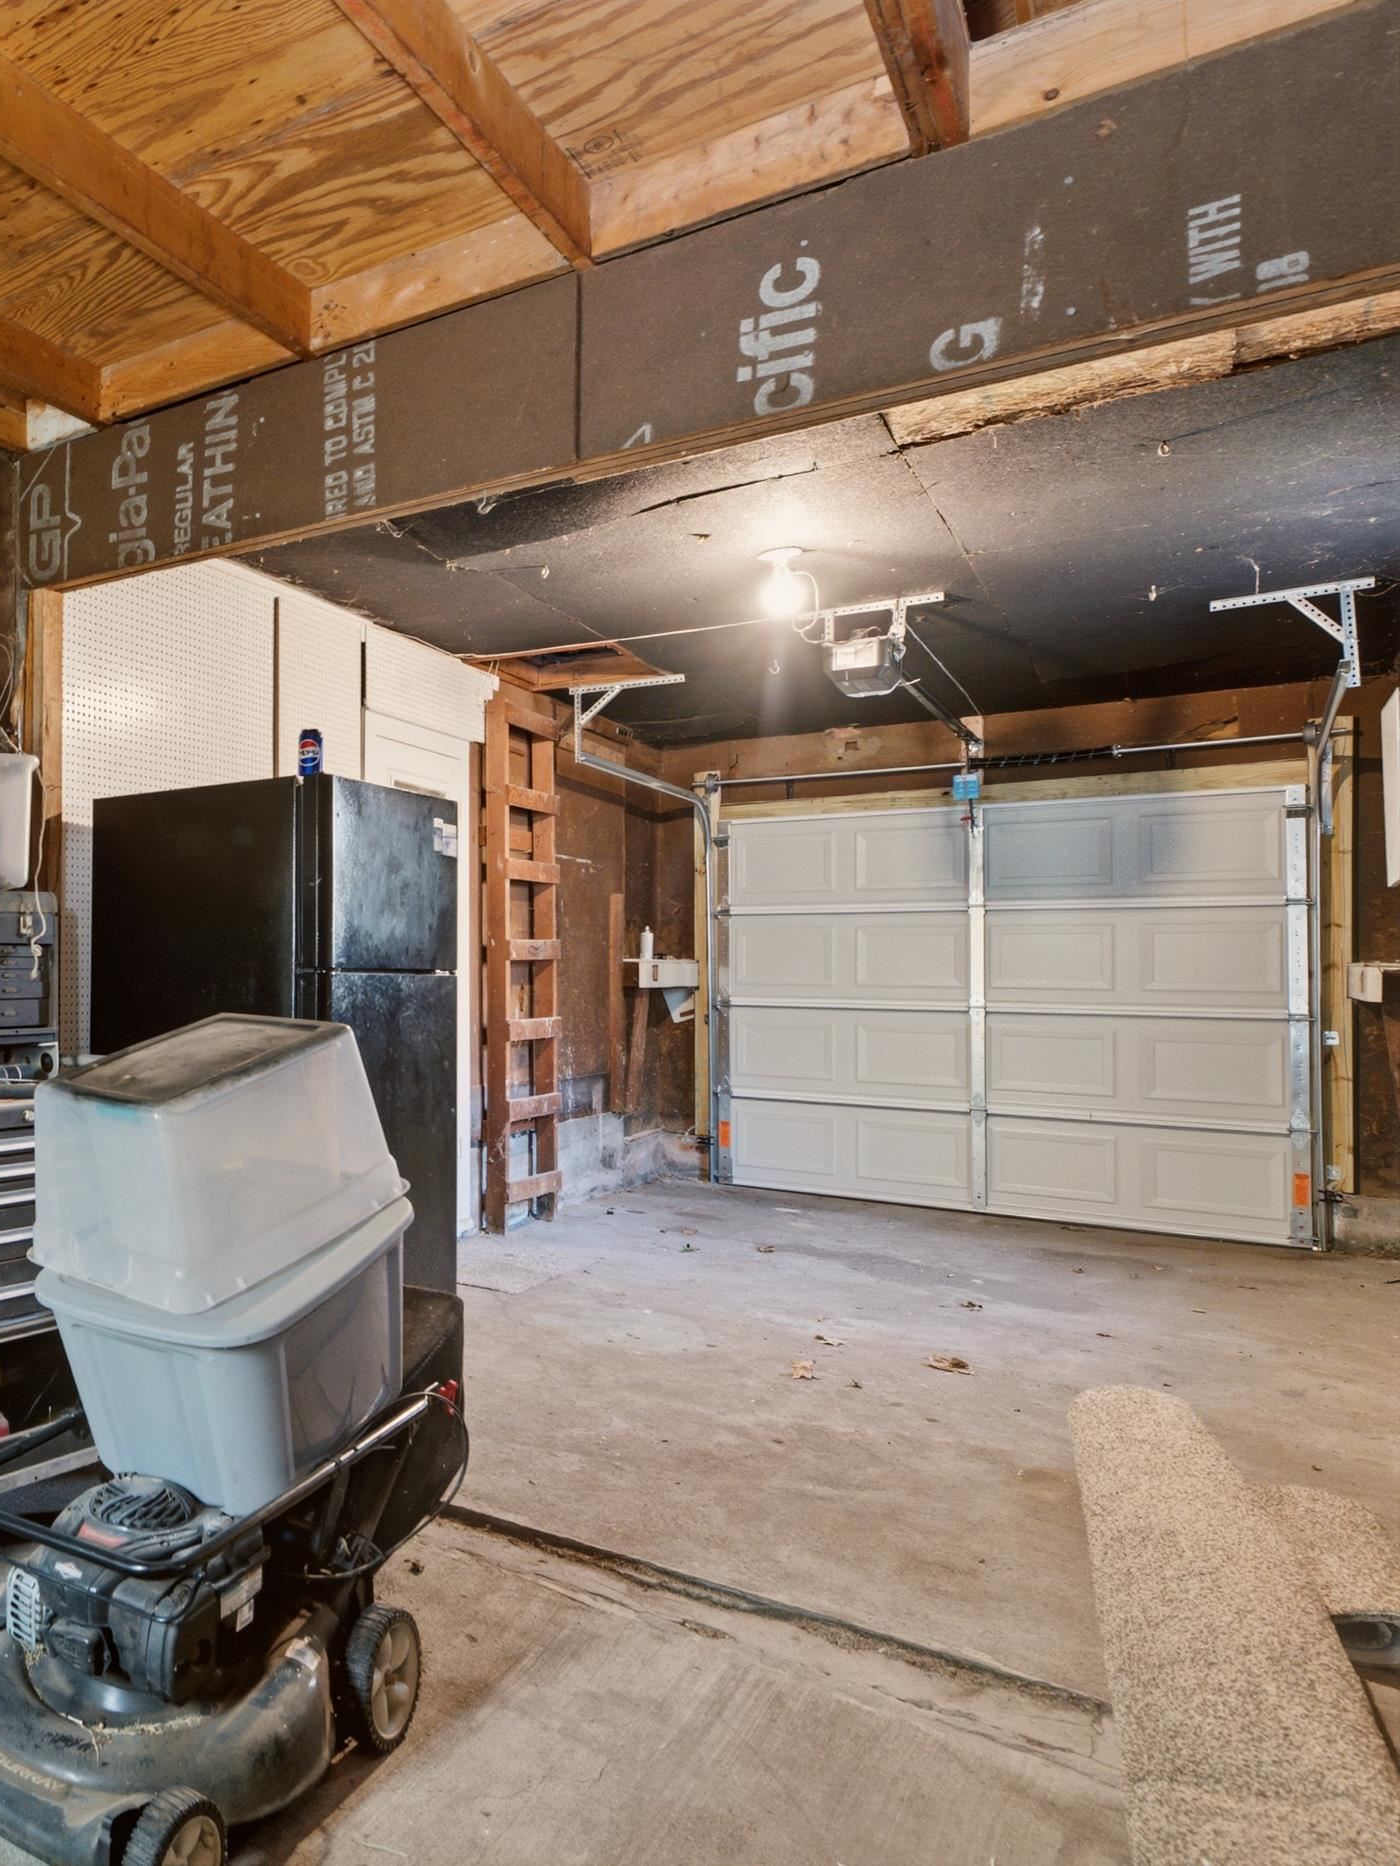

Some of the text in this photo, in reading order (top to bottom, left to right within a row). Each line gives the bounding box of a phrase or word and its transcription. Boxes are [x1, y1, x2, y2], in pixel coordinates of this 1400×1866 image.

[1187, 193, 1242, 285] WITH
[734, 256, 823, 416] cific
[927, 315, 1005, 372] G
[324, 351, 348, 432] COMPL
[352, 371, 376, 391] C
[109, 417, 157, 569] gia-Pa
[324, 434, 348, 467] TO
[28, 482, 63, 581] GP
